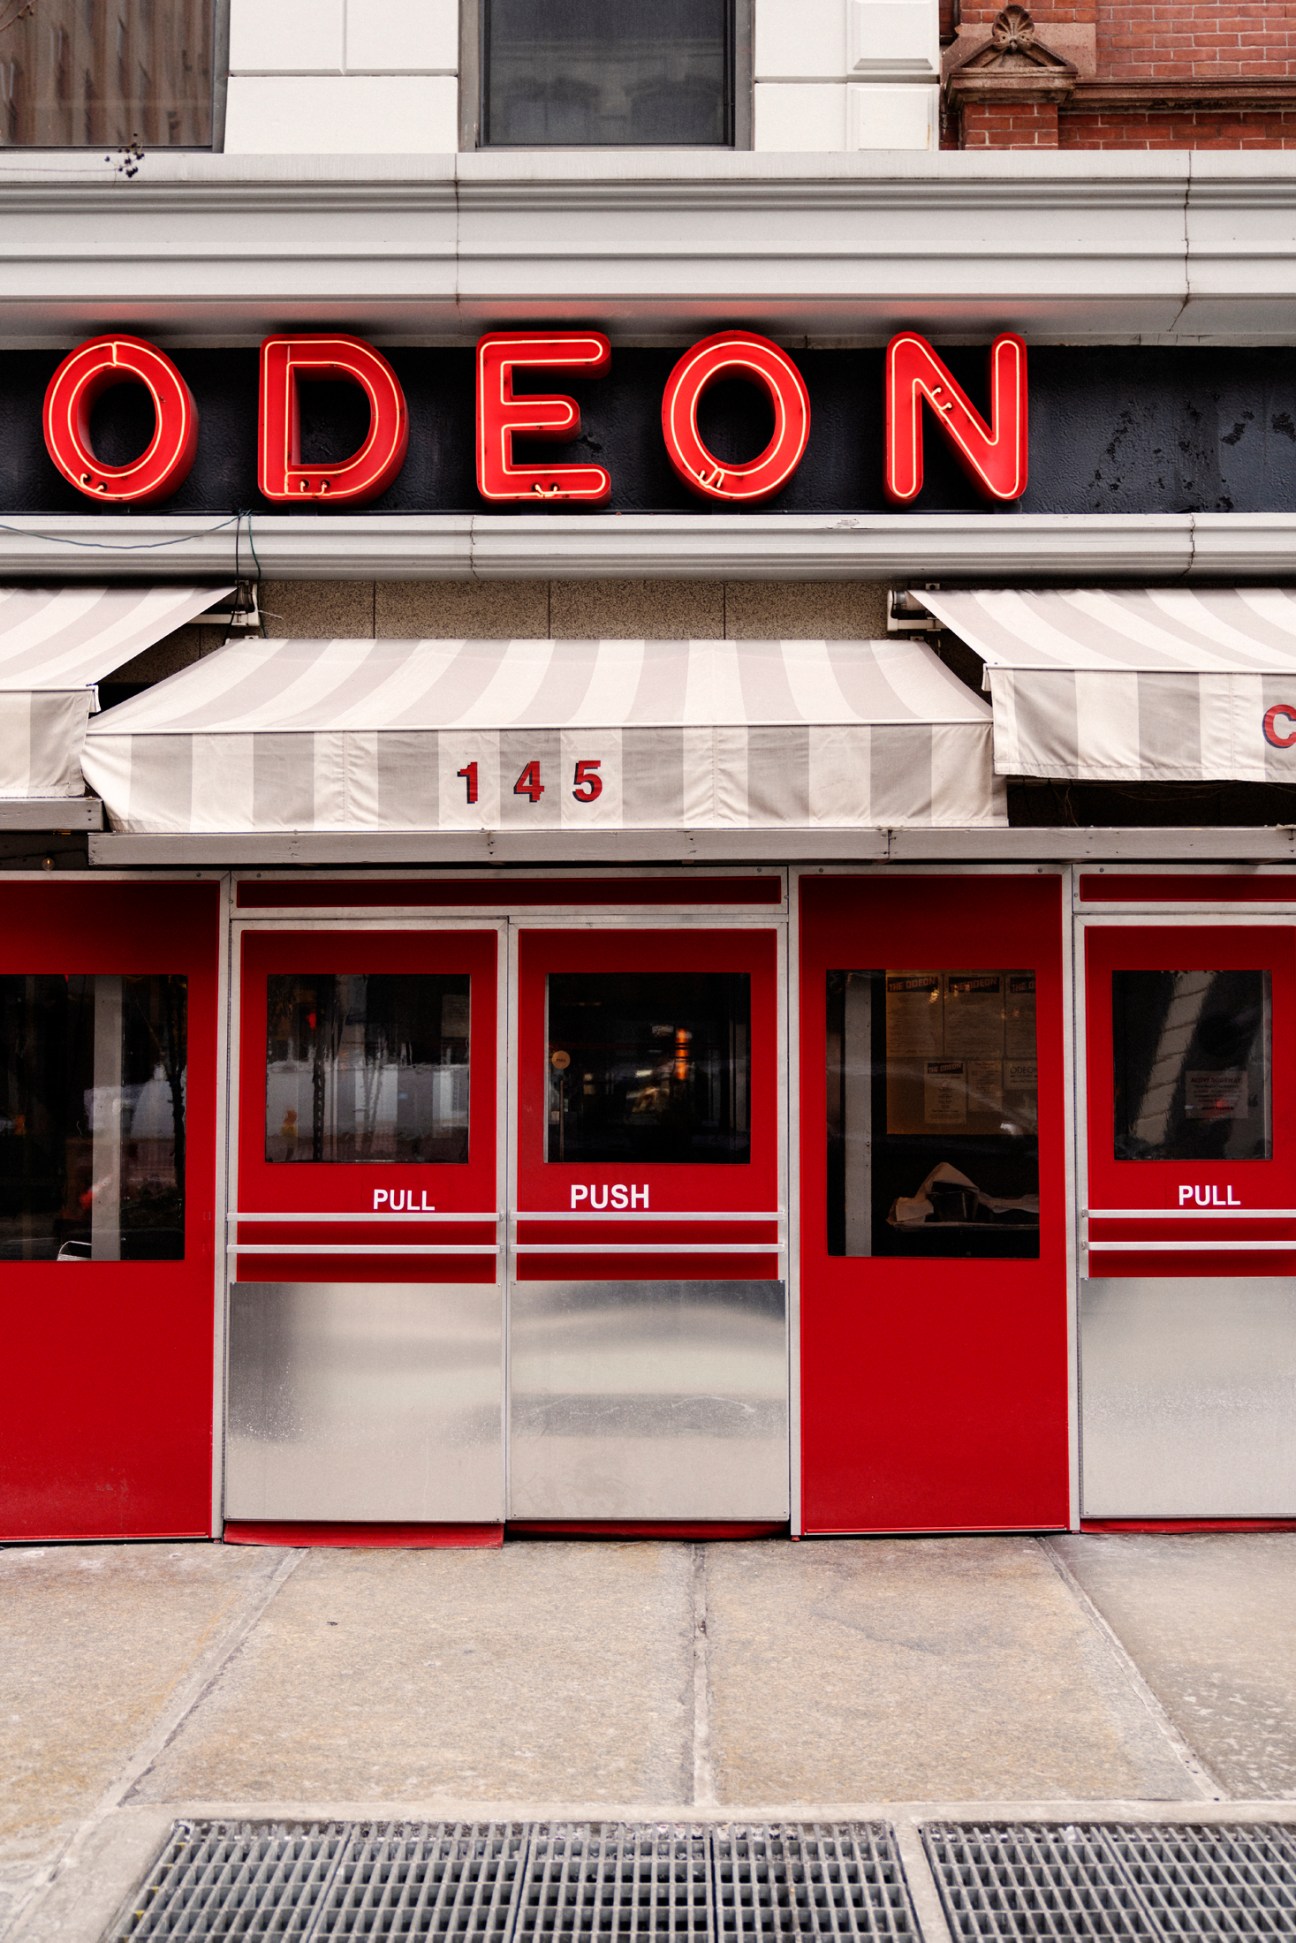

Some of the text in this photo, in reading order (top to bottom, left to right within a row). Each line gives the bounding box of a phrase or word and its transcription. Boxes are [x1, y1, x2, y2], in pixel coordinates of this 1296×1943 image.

[43, 330, 1029, 505] ODEON
[457, 760, 603, 804] 145
[905, 976, 937, 990] ODEON
[373, 1189, 435, 1211] PULL
[570, 1184, 650, 1209] PUSH
[1178, 1185, 1241, 1206] PULL
